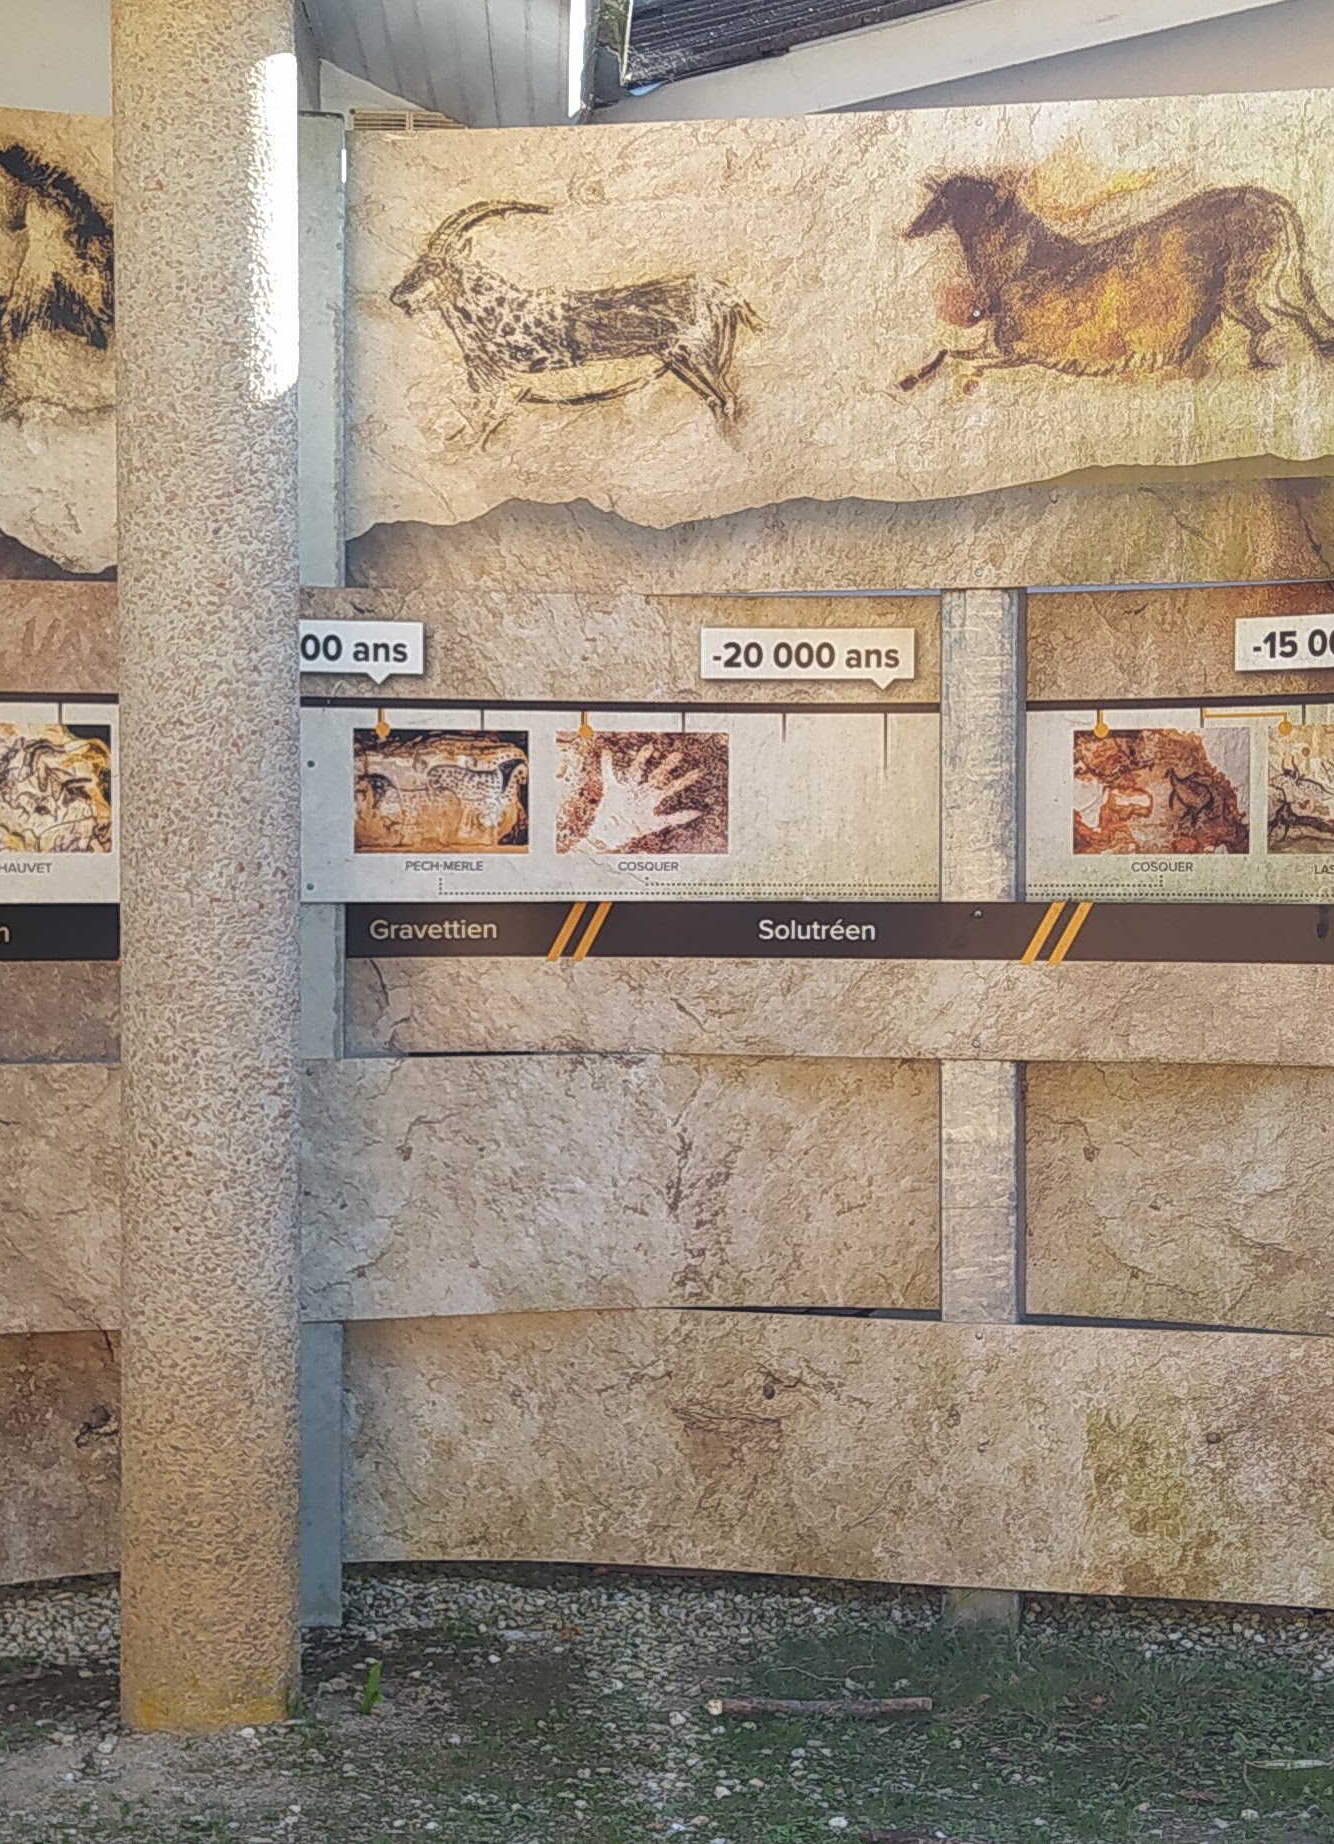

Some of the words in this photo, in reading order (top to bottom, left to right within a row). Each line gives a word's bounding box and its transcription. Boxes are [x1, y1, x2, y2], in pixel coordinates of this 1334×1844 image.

[300, 634, 343, 662] 00
[352, 641, 408, 663] ans
[712, 641, 763, 669] -20
[772, 642, 836, 669] 000
[845, 645, 900, 670] ans
[1252, 630, 1299, 659] -15
[405, 861, 484, 873] PECH-MERLE
[618, 861, 680, 874] COSQUER
[1130, 861, 1194, 875] COSQUER
[369, 918, 498, 940] Gravettien
[758, 918, 876, 942] Solutréen
